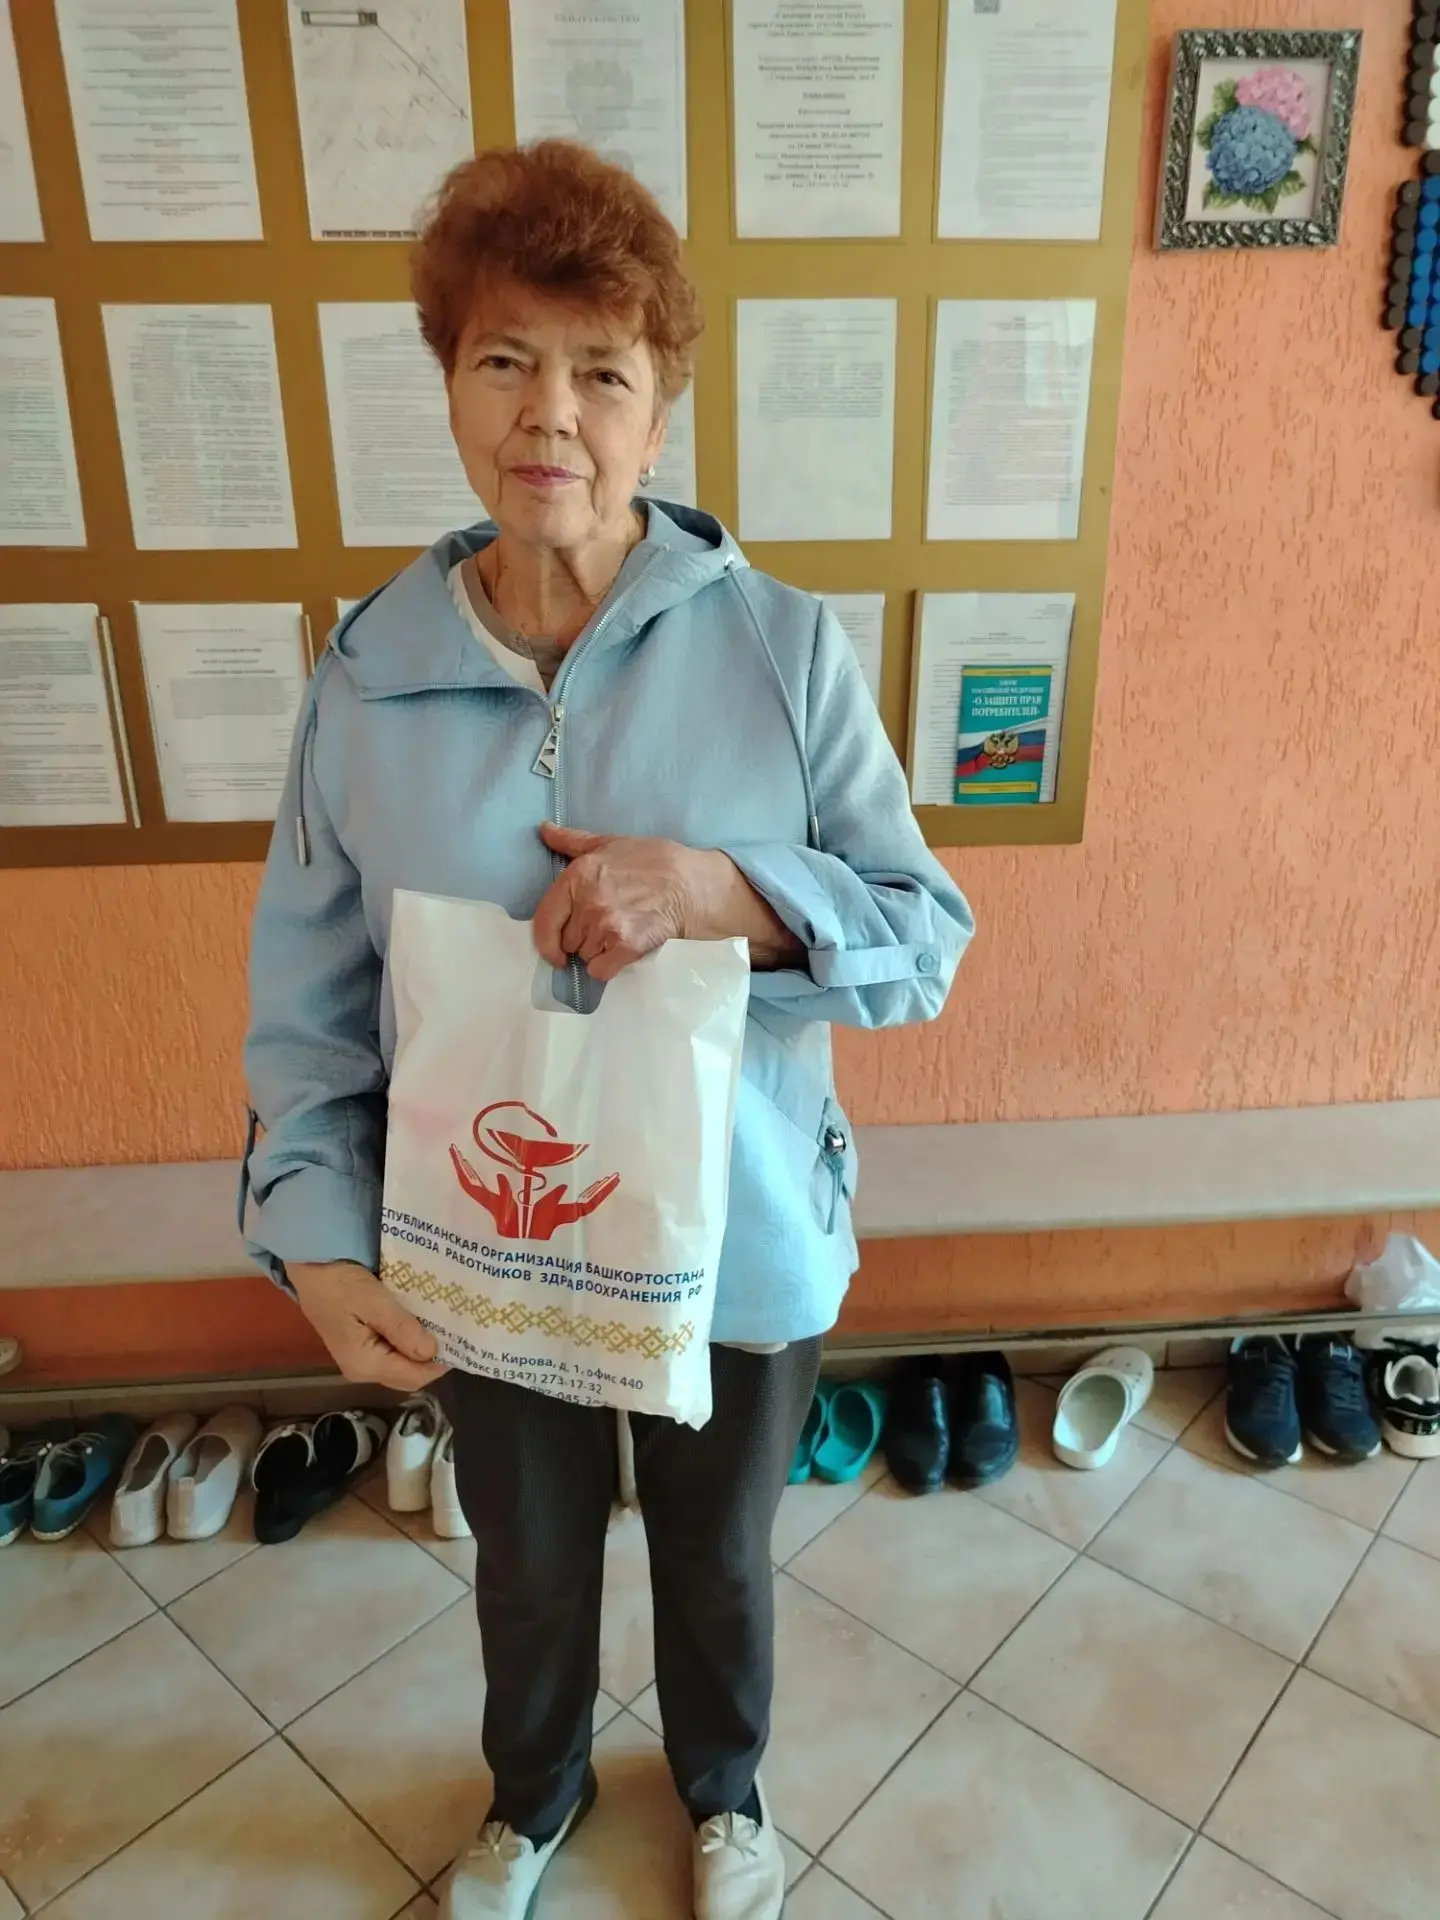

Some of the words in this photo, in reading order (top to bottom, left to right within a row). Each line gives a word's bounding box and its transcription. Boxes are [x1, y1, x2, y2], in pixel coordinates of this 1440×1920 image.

[445, 1247, 532, 1281] РАБОТНИКОВ
[540, 1272, 682, 1303] ЗДРАВООХРАНЕНИЯ
[687, 1284, 702, 1299] РФ
[481, 1246, 582, 1274] ОРГАНИЗАЦИЯ
[586, 1262, 705, 1286] БАШКОРТОСТАНА
[481, 1348, 498, 1361] ул.
[501, 1352, 557, 1369] Кирова,
[559, 1362, 570, 1373] д.
[586, 1368, 617, 1384] офис
[619, 1376, 644, 1390] 440
[493, 1369, 500, 1377] 8
[503, 1369, 537, 1383] (347)
[540, 1373, 603, 1396] 273-17-32
